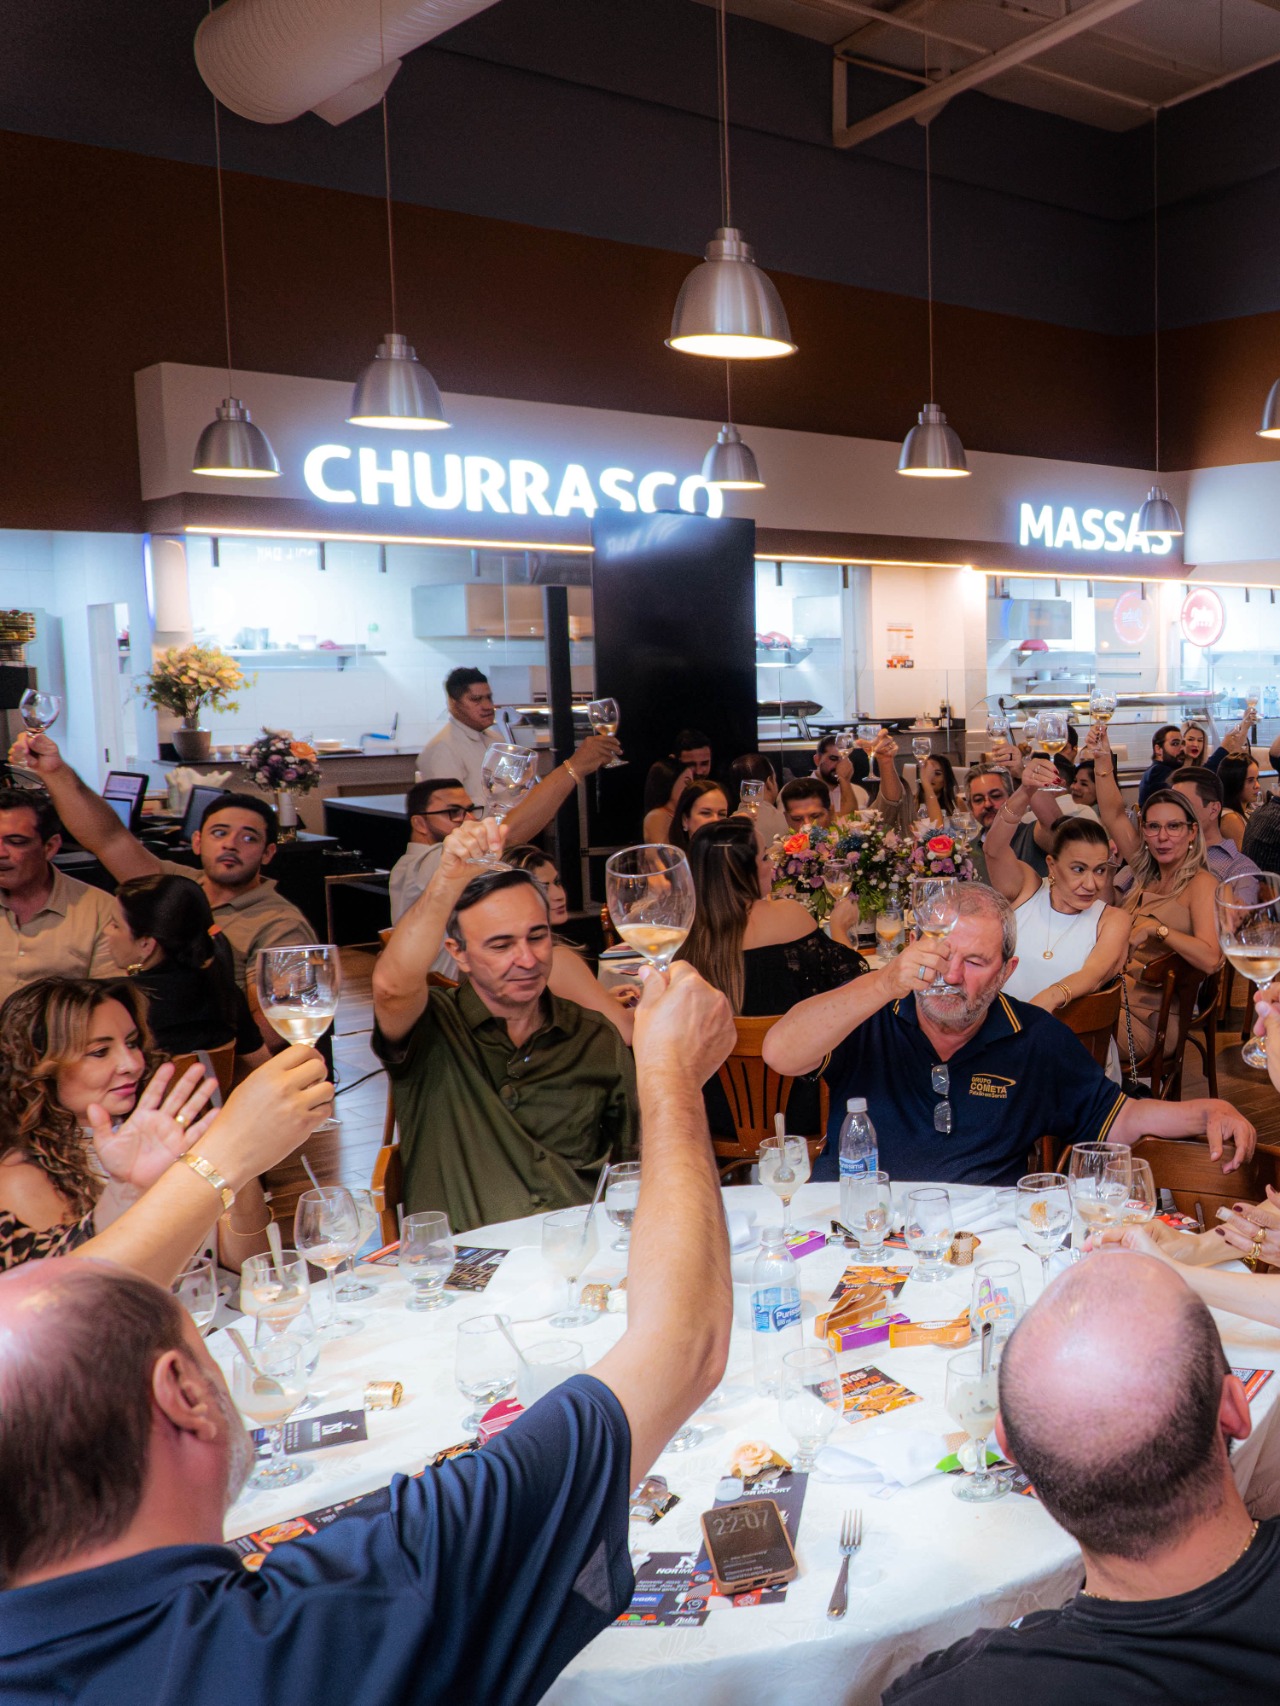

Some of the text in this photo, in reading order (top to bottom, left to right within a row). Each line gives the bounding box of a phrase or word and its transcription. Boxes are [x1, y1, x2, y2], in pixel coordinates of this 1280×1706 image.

[303, 444, 724, 518] CHURRASCO
[970, 1082, 1007, 1093] COMETA
[757, 1486, 792, 1495] IMPORT
